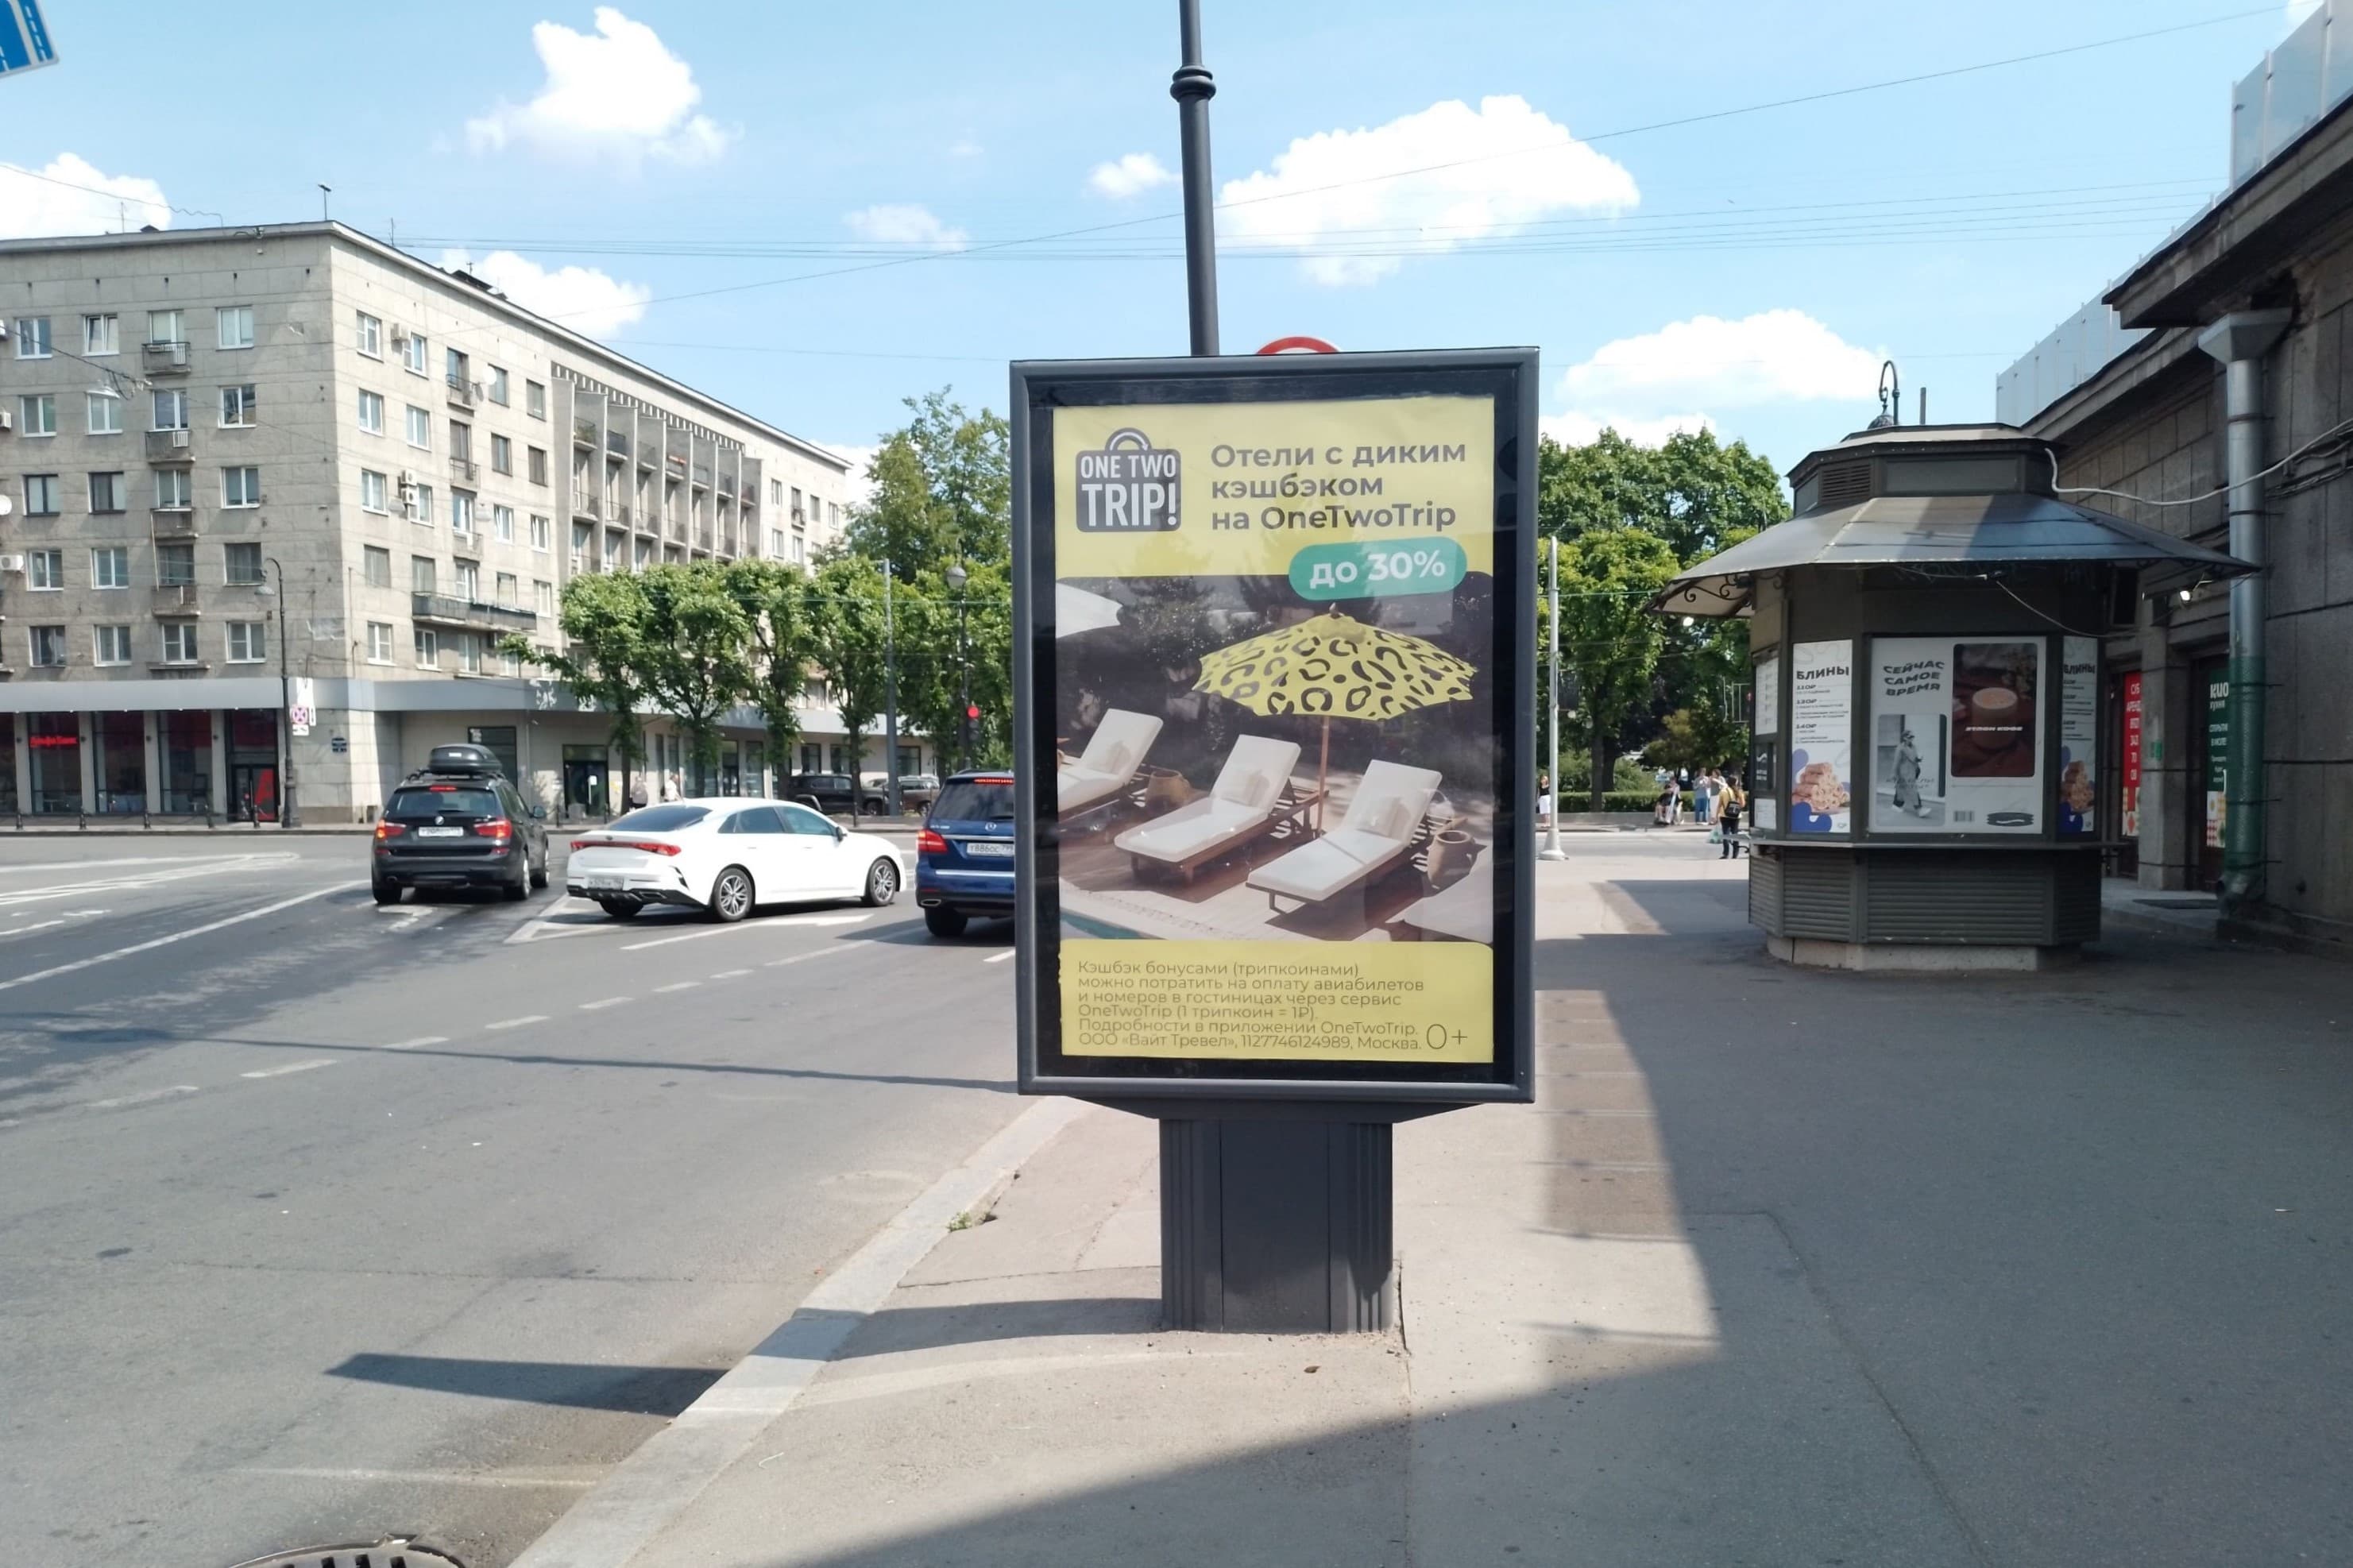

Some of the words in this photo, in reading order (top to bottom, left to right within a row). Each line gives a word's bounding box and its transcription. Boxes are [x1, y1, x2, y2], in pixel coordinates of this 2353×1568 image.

[1211, 443, 1315, 468] Отели
[1324, 446, 1343, 465] с
[1352, 443, 1466, 468] диким
[1080, 455, 1122, 478] ONE
[1127, 454, 1176, 477] TWO
[1211, 472, 1383, 499] кэшбэком
[1081, 482, 1176, 527] TRIP!
[1211, 511, 1250, 530] на
[1261, 500, 1457, 532] OneTwoTrip
[1309, 560, 1358, 589] до
[1366, 549, 1447, 582] 30%
[1795, 666, 1849, 680] БЛИНЫ
[1883, 660, 1945, 674] СЕЙЧАС
[1884, 672, 1941, 686] САМОЕ
[1885, 683, 1941, 697] ВРЕМЯ
[1078, 960, 1141, 974] Кэшбэк
[1146, 960, 1227, 977] бонусами
[1233, 961, 1359, 978] (трипкоинами)
[1078, 978, 1134, 988] можно
[1138, 979, 1223, 990] потратить
[1227, 979, 1247, 990] на
[1251, 979, 1310, 993] оплату
[1313, 977, 1424, 991] авиабилетов
[1078, 993, 1088, 1002] и
[1093, 993, 1168, 1006] номеров
[1172, 994, 1182, 1003] в
[1186, 994, 1282, 1006] гостиницах
[1286, 994, 1335, 1007] через
[1340, 994, 1402, 1008] сервис
[1078, 1004, 1173, 1018] OneTwoTrip
[1176, 1005, 1188, 1020] (1
[1192, 1006, 1273, 1022] трипкоин
[1079, 1018, 1190, 1033] Подробности
[1195, 1022, 1204, 1033] в
[1208, 1022, 1316, 1035] приложении
[1320, 1021, 1418, 1037] OneTwoTrip.
[1078, 1033, 1119, 1046] ООО
[1121, 1033, 1168, 1046] «Вайт
[1241, 1034, 1353, 1049] 1127746124989,
[1358, 1037, 1422, 1050] Москва.
